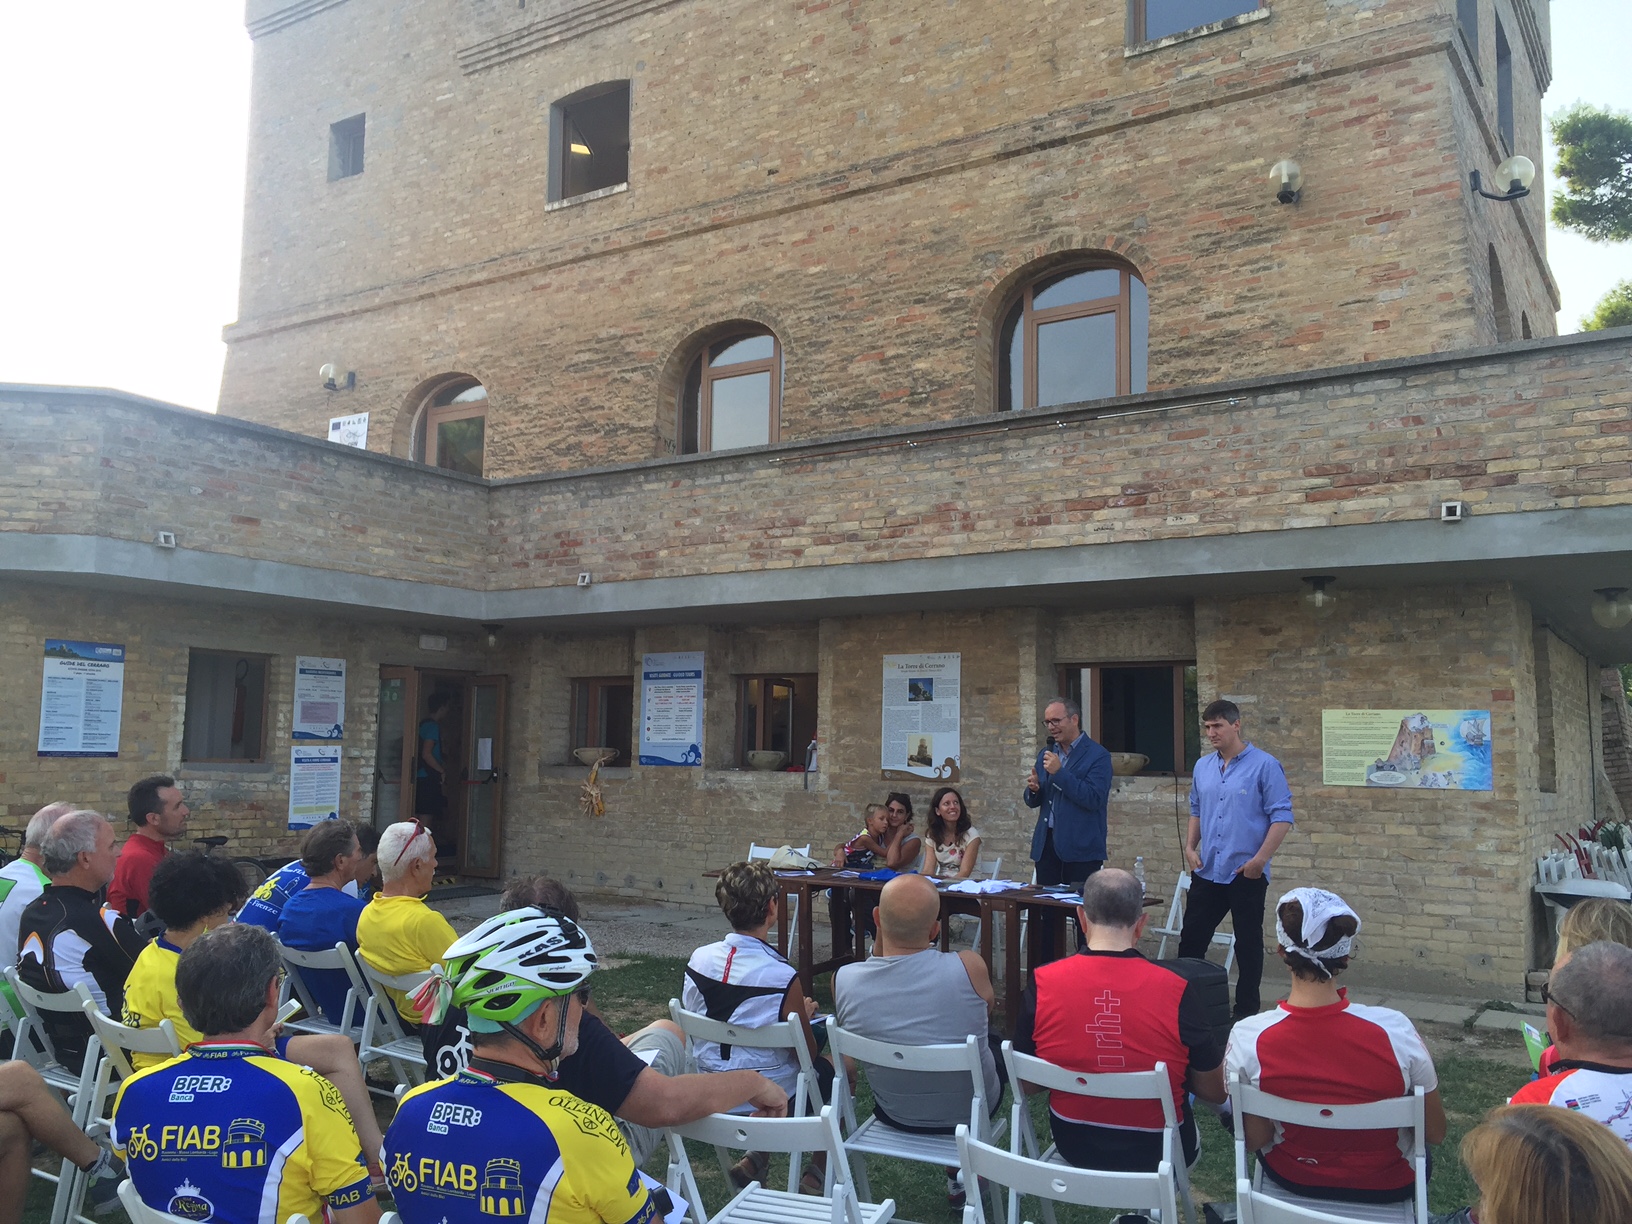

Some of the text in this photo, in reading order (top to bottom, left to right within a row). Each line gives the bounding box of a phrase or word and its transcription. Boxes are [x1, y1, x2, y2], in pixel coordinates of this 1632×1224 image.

[252, 900, 279, 915] Firenze
[486, 981, 516, 994] VERTIGO
[210, 1051, 228, 1059] FIAB
[428, 1123, 447, 1133] Banca
[548, 1096, 628, 1157] MOLINETTO
[161, 1125, 221, 1150] FIAB
[420, 1158, 478, 1191] FIAB
[329, 1190, 361, 1206] FIAB
[174, 1200, 207, 1213] Regina
